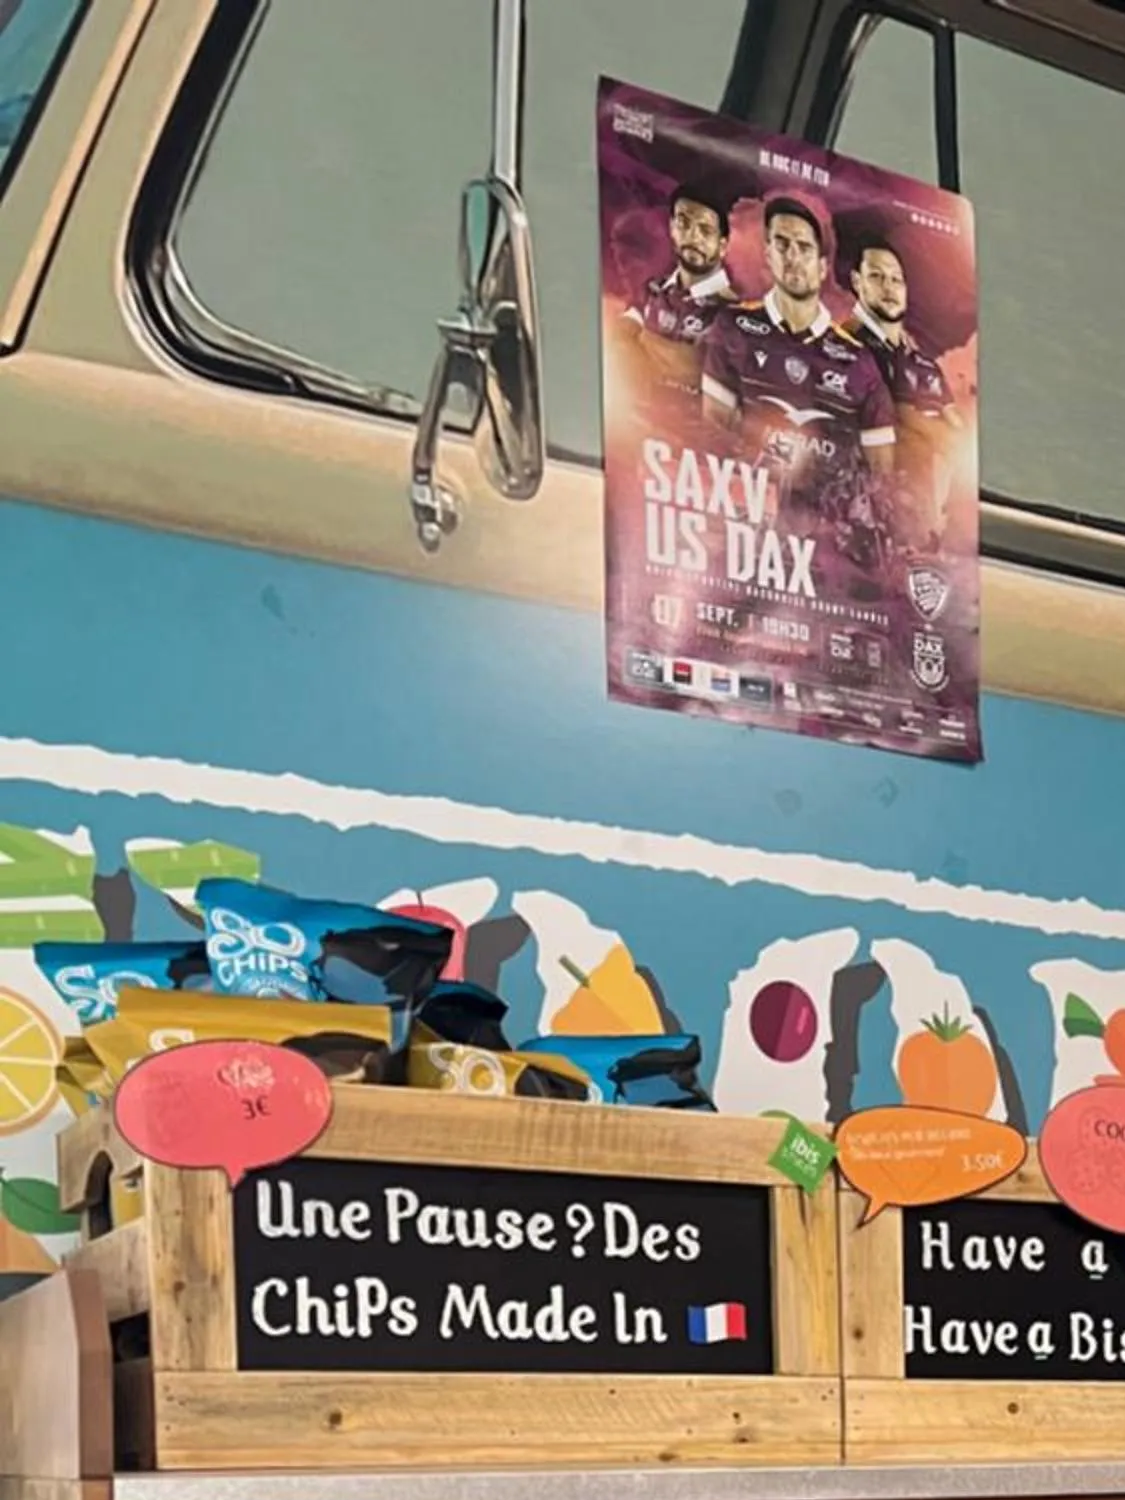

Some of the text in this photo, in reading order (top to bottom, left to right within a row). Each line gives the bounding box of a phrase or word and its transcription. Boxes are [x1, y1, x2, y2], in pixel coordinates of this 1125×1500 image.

[643, 439, 769, 524] SAXV
[646, 502, 817, 598] US DAX
[256, 1180, 372, 1239] Une
[604, 1203, 701, 1261] Des
[920, 1220, 1046, 1270] Have
[439, 1283, 599, 1343] Made
[904, 1305, 1020, 1355] Have
